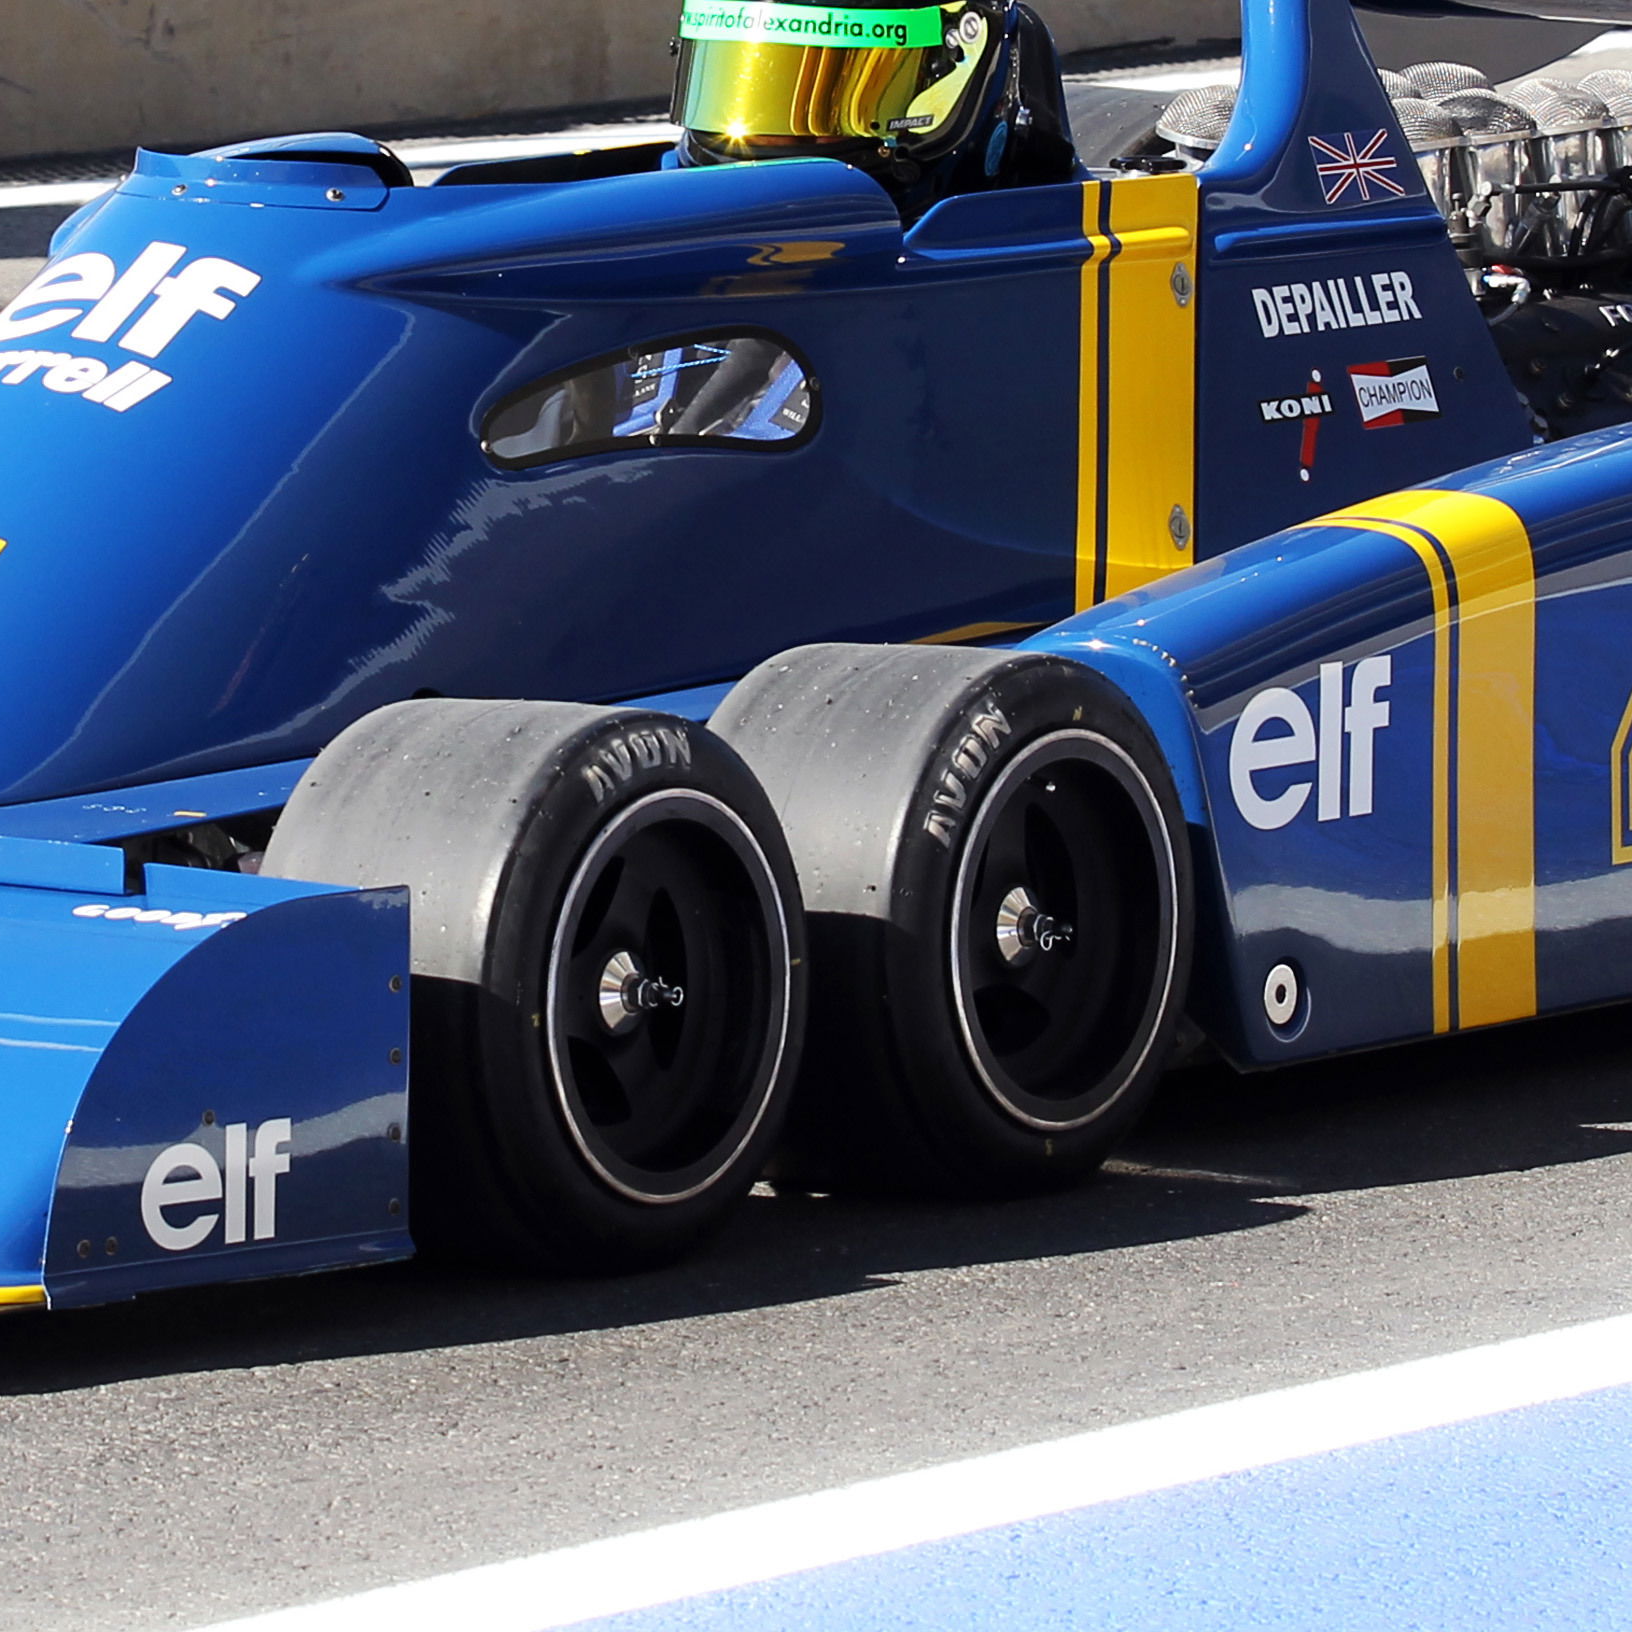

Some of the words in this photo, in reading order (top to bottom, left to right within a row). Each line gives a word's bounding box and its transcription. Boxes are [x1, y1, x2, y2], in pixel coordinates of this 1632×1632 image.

[889, 116, 932, 130] IMPACT
[1252, 271, 1423, 338] DEPAILLER
[1261, 394, 1333, 420] KONI
[1358, 378, 1433, 408] CHAMPION
[581, 727, 692, 806] AVON
[923, 701, 1012, 848] AVON
[1229, 655, 1392, 830] elf
[140, 1117, 292, 1251] elf
